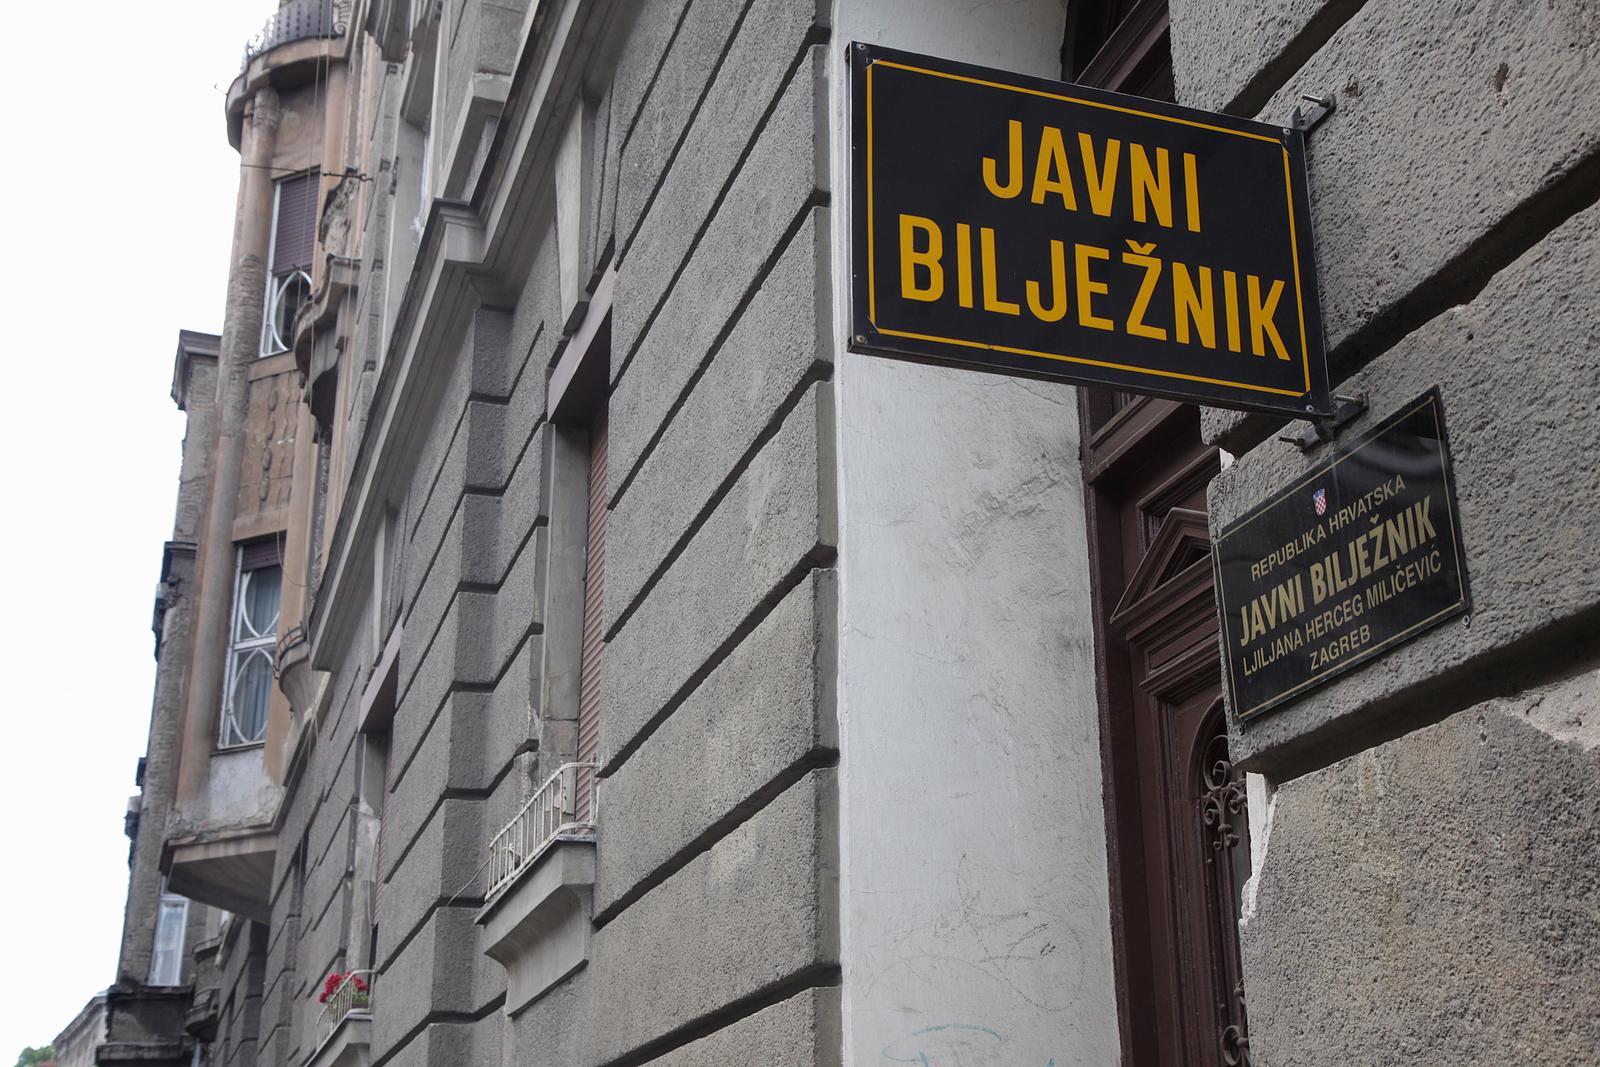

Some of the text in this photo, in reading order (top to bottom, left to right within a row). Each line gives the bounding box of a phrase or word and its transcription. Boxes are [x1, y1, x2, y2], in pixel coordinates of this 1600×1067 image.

[982, 119, 1201, 233] JAVNI
[899, 213, 1291, 361] BILJEŽNIK
[1240, 495, 1437, 647] JAVNI BILJEŽNIK
[1251, 474, 1406, 582] REPUBLIKA HRVATSKA
[1243, 544, 1442, 677] LJILJANA HERCEG MILIČEVIĆ
[1309, 624, 1371, 671] ZAGREB
